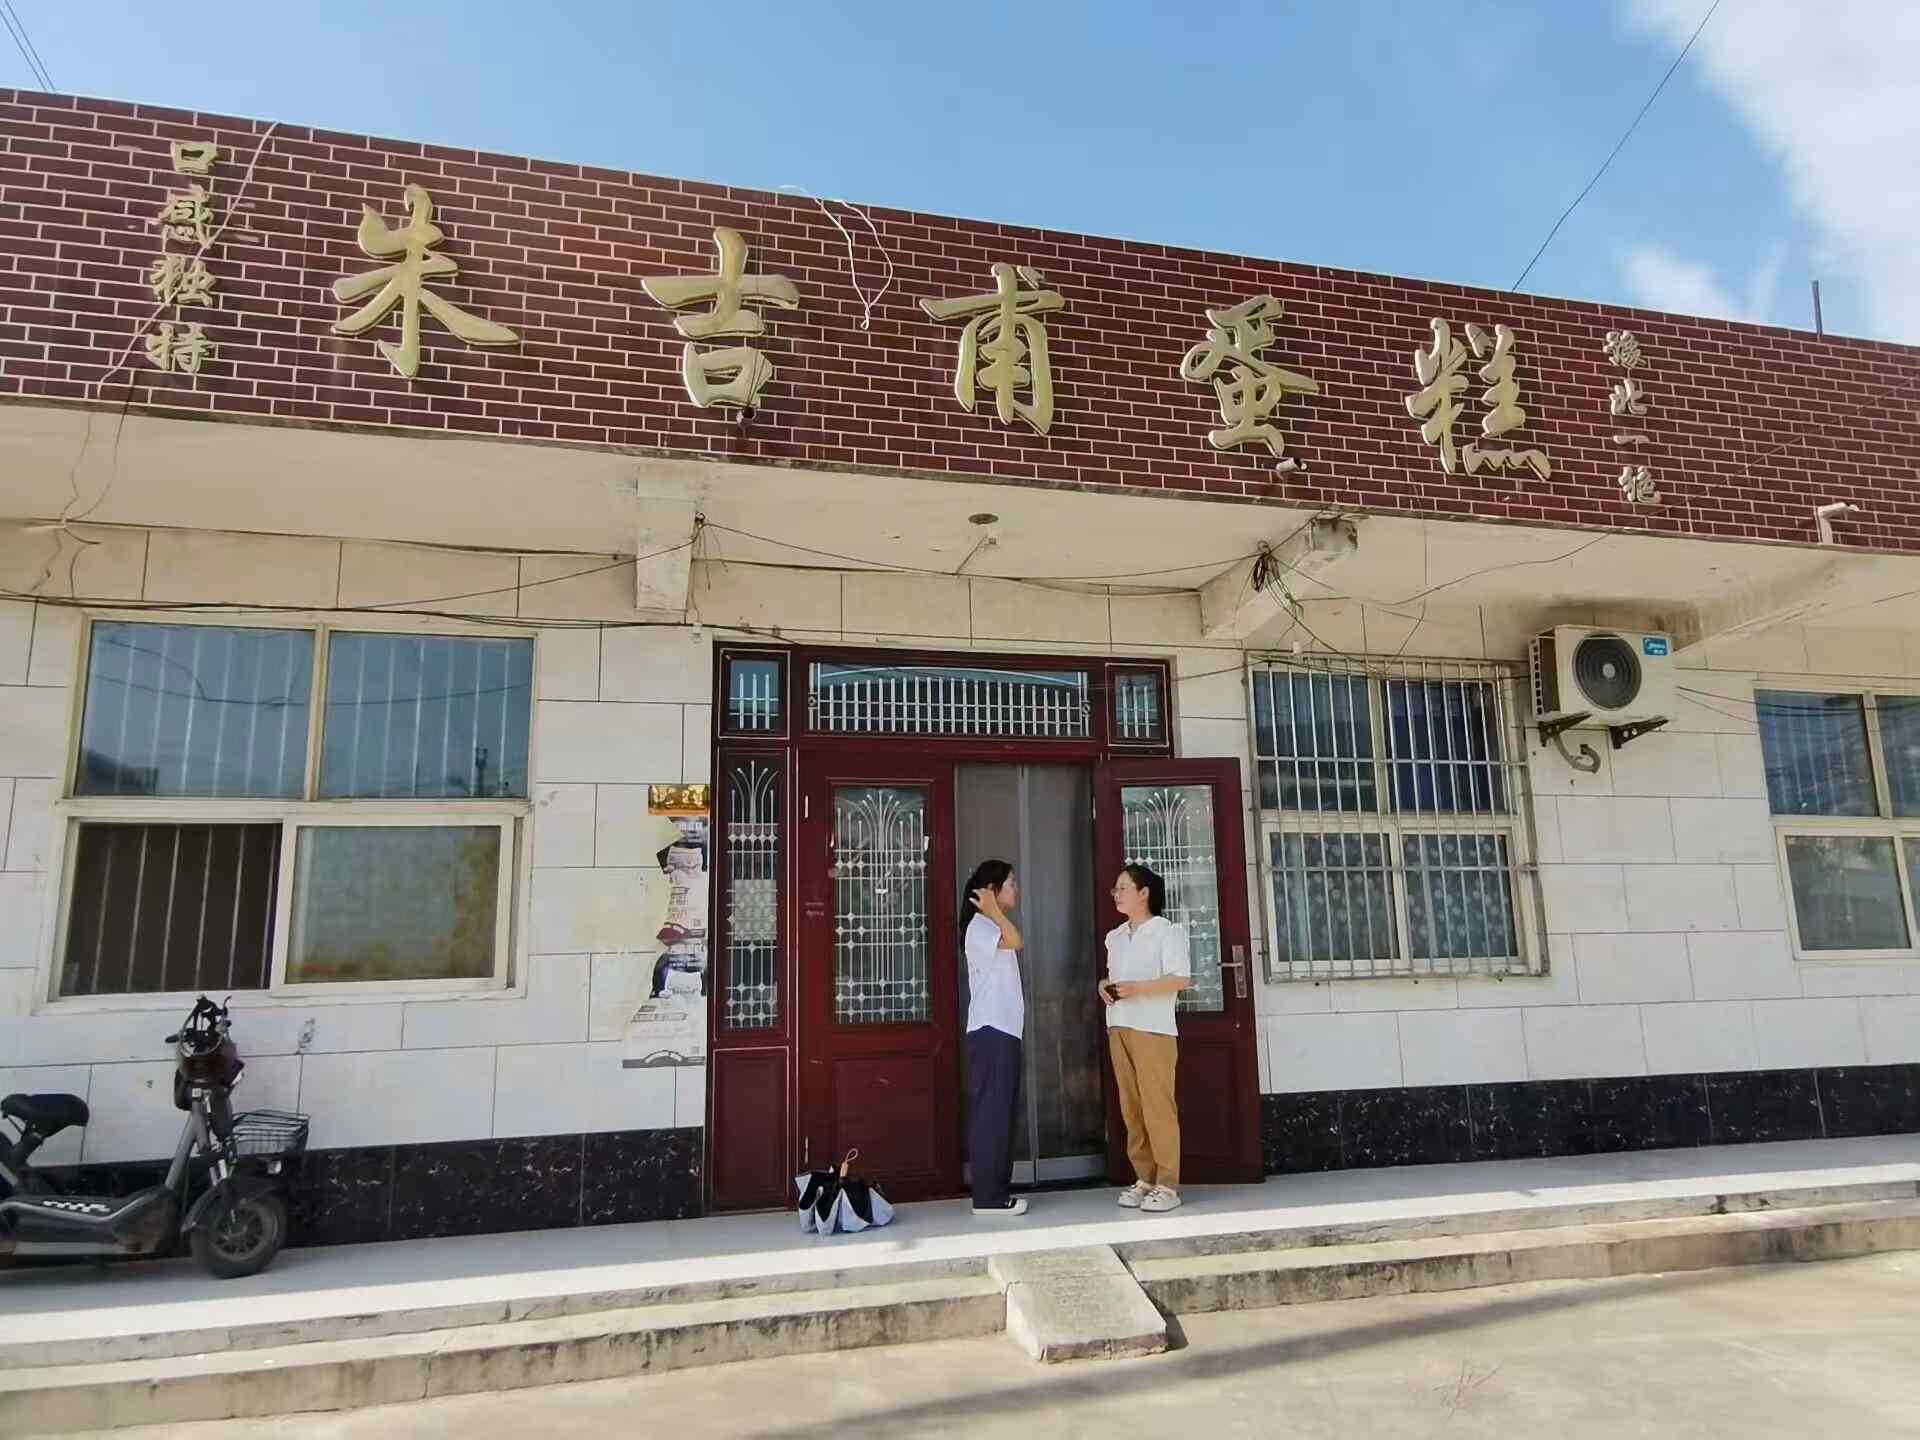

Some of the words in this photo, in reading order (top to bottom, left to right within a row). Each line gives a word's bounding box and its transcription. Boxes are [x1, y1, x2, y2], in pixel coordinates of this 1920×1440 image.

[145, 140, 218, 374] 口感独特
[330, 182, 1553, 483] 朱吉甫蛋糕
